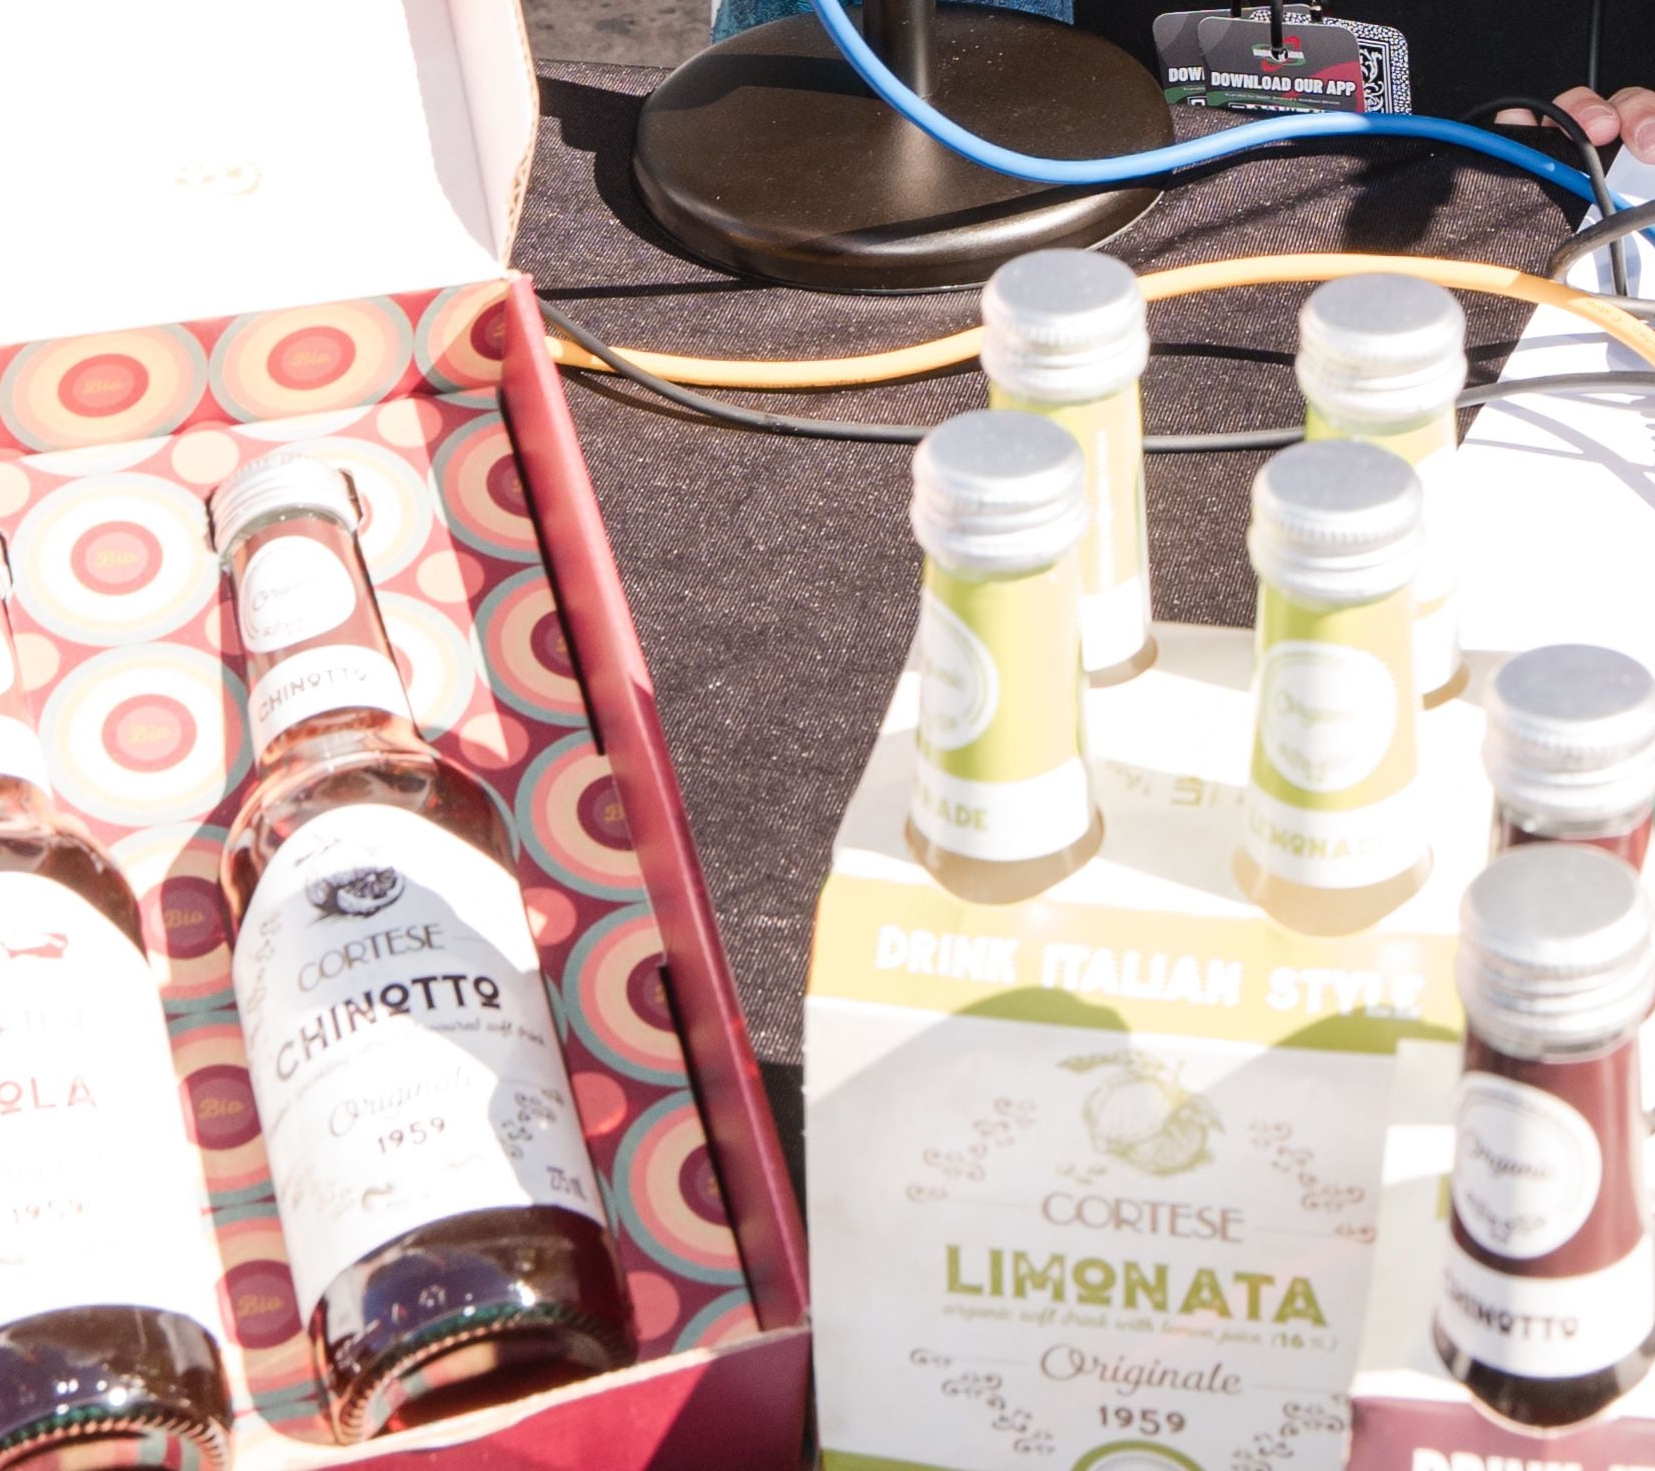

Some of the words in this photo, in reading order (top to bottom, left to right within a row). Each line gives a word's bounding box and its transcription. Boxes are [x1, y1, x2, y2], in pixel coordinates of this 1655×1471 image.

[1210, 71, 1292, 93] DOWNLOAD
[1293, 76, 1323, 94] OUR
[1326, 79, 1356, 97] APP
[297, 923, 446, 993] CORTESE
[874, 923, 1018, 987] DRINK
[1038, 942, 1244, 1010] ITALIAN
[1264, 965, 1426, 1022] STYLE
[275, 974, 501, 1082] CHINOTTO
[377, 1116, 446, 1155] 1959
[1040, 1188, 1246, 1246] CORTESE
[942, 1243, 1329, 1330] LIMONATA
[1039, 1342, 1243, 1397] Originale
[1097, 1403, 1187, 1436] 1959
